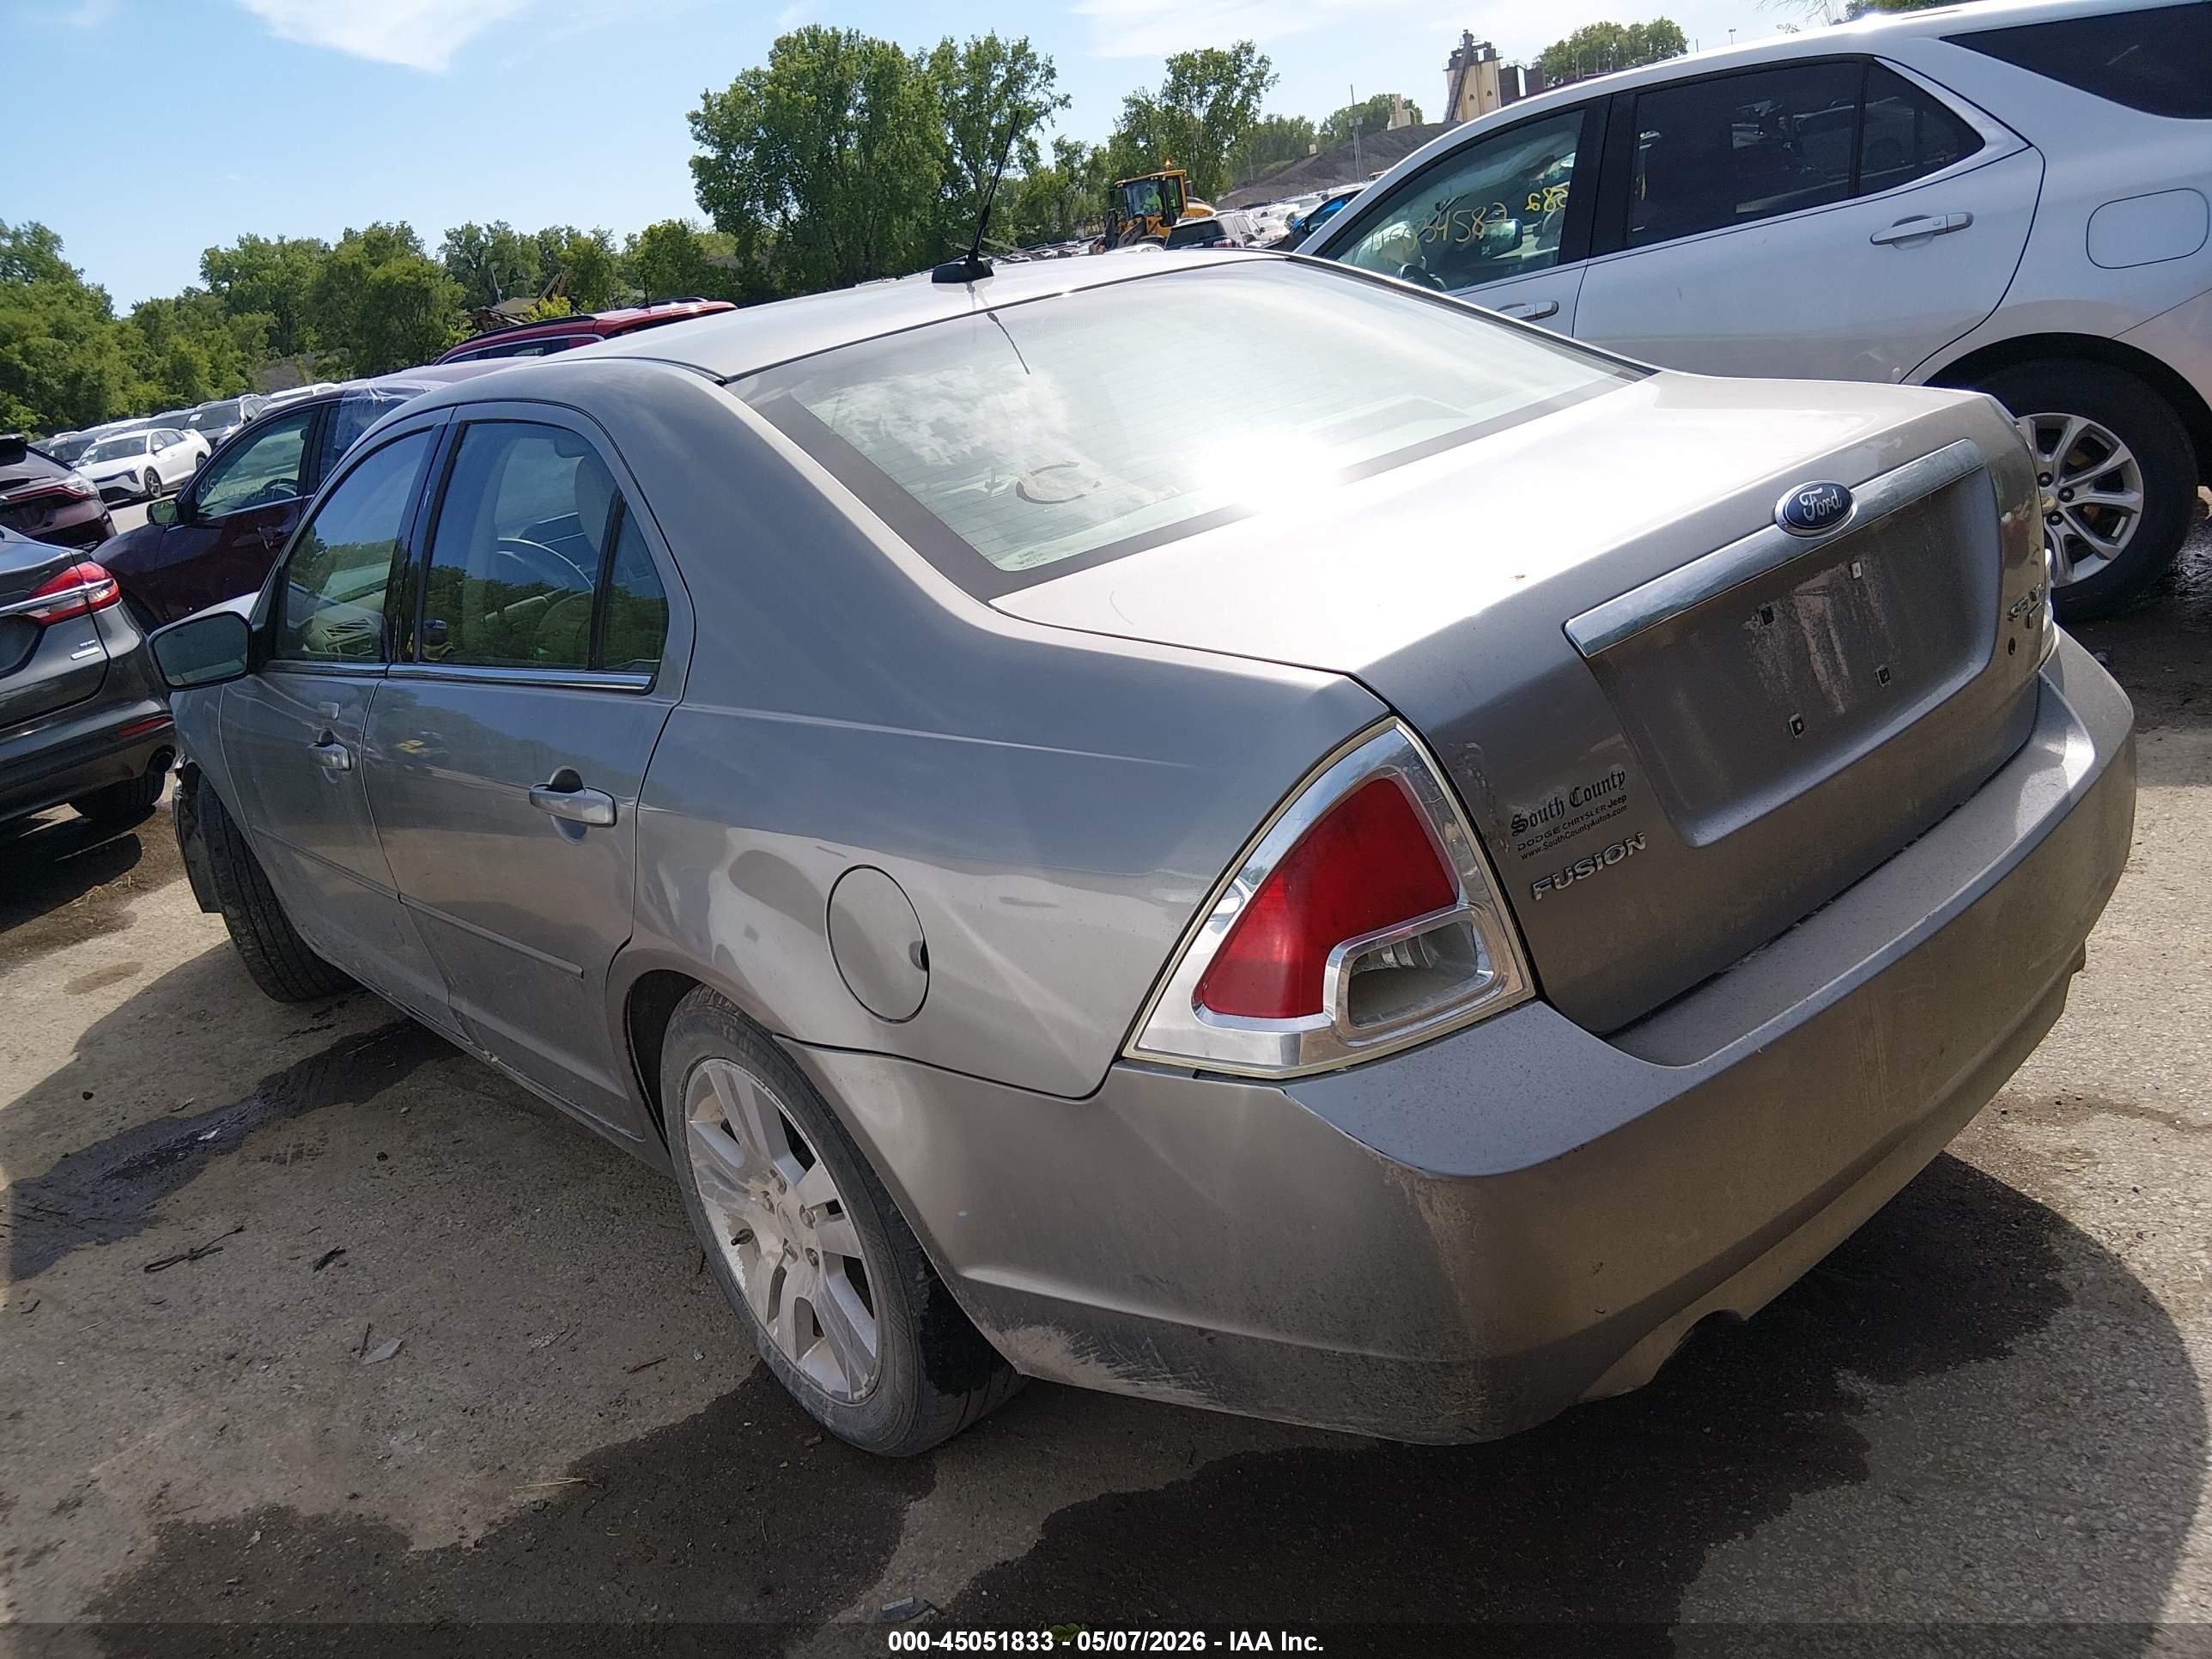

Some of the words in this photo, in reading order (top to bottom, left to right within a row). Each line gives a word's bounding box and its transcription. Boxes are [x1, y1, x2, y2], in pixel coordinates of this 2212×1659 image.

[1799, 487, 1842, 522] Ford
[1510, 797, 1565, 837] South
[1569, 770, 1626, 808] County
[1516, 825, 1561, 851] DODGE
[1562, 804, 1607, 830] CHRYSLER
[1607, 794, 1628, 809] Jeep
[1519, 804, 1629, 861] www.SouthCountyAutos.com
[1531, 831, 1648, 901] FUSION
